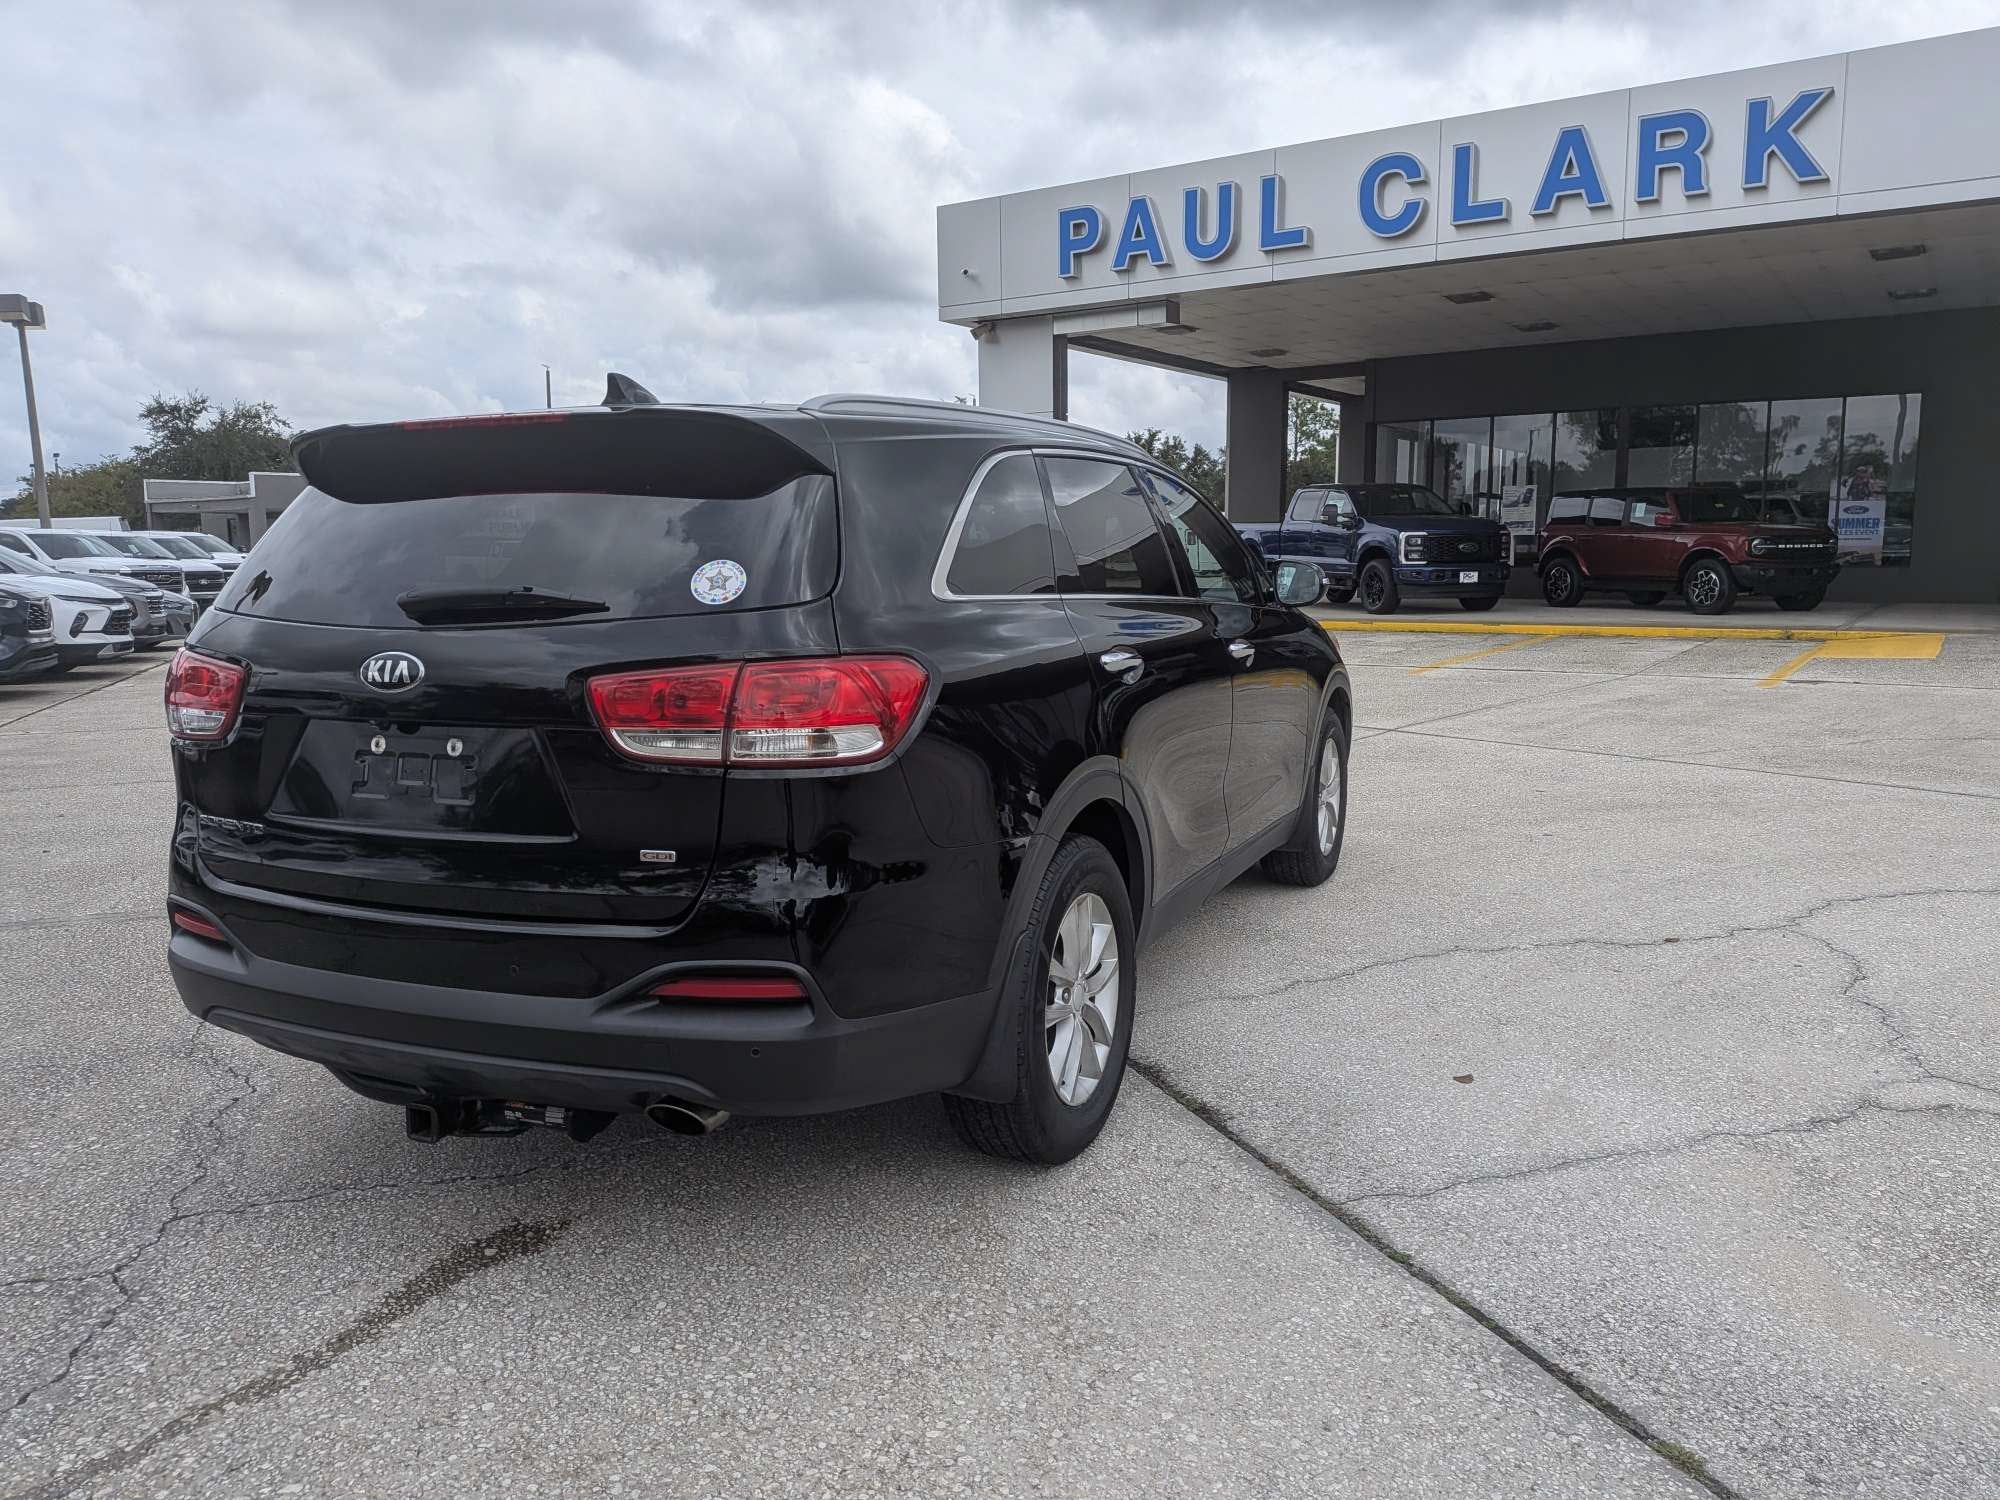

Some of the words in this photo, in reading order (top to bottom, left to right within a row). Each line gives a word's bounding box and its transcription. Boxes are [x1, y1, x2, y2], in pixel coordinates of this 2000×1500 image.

[1057, 173, 1312, 281] PAUL
[1357, 86, 1836, 240] CLARK
[367, 659, 411, 684] KIA
[641, 852, 674, 861] GDI
